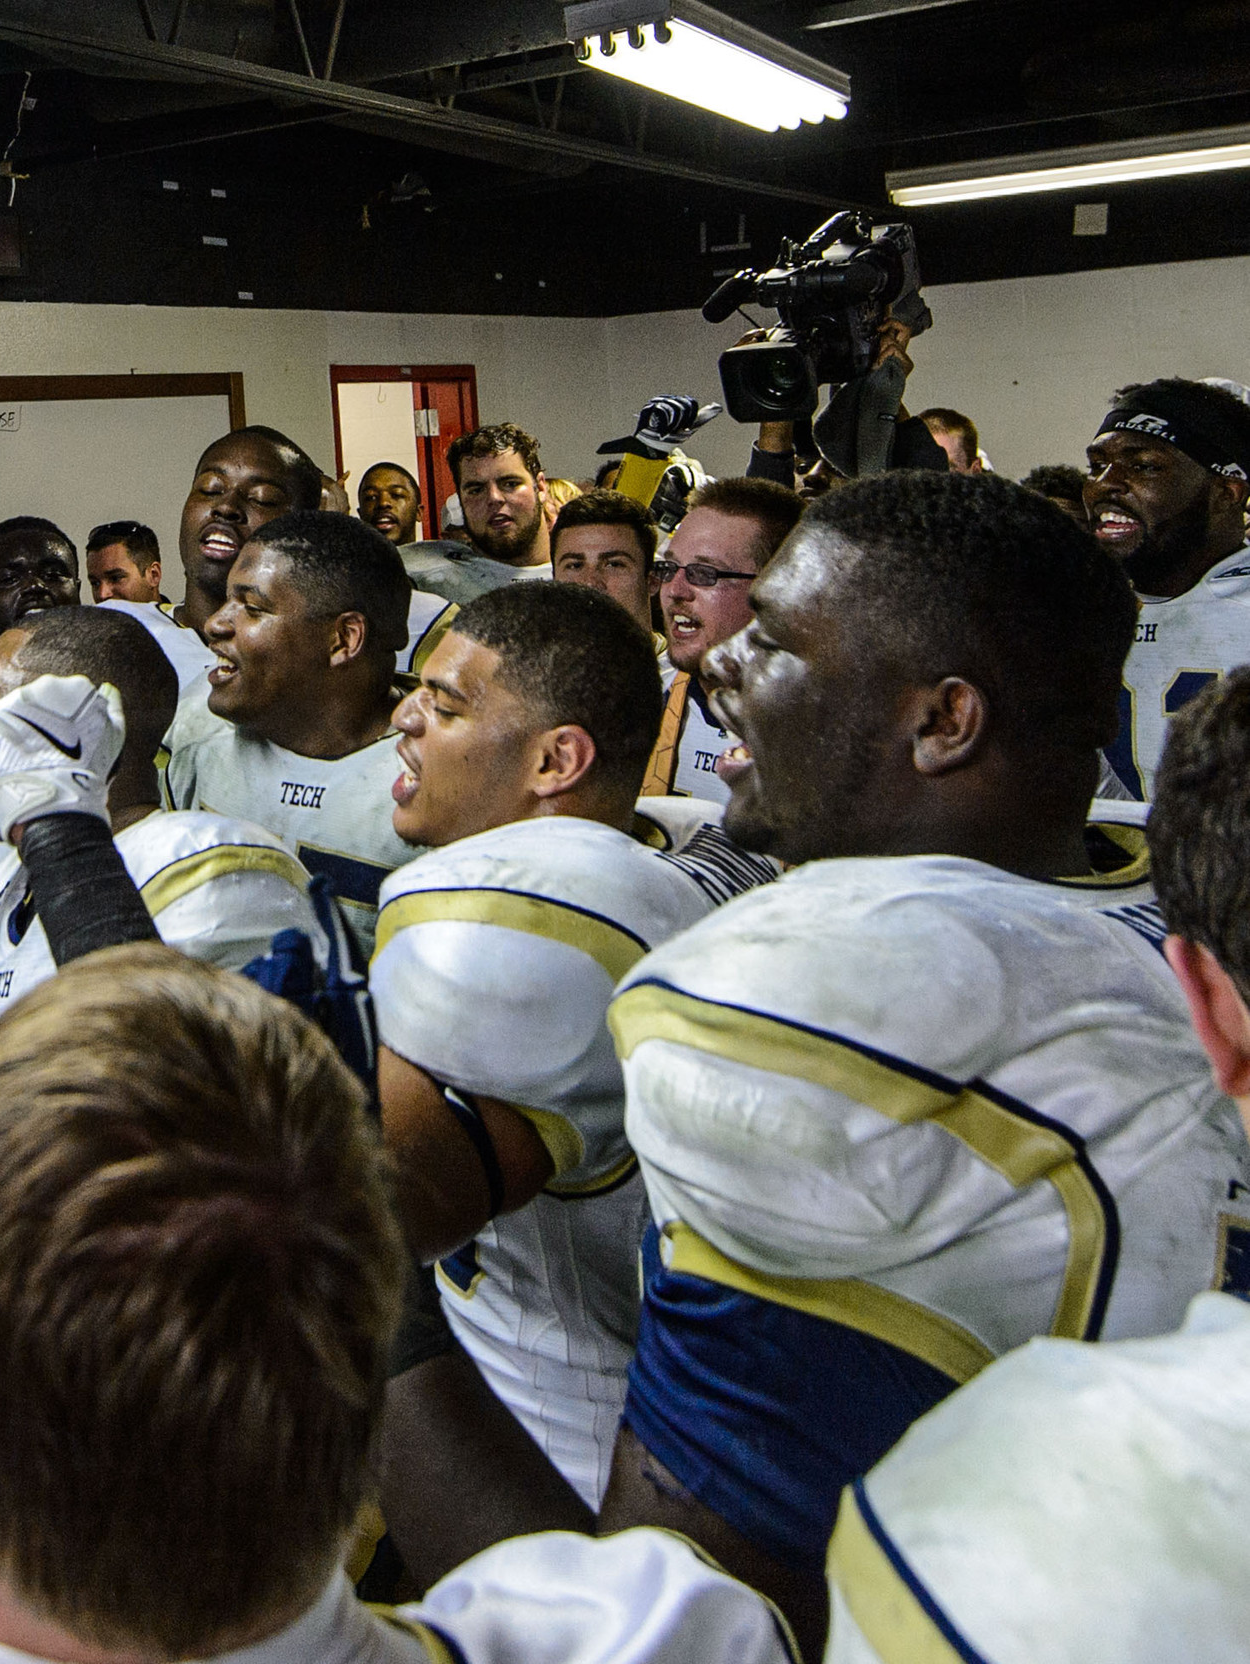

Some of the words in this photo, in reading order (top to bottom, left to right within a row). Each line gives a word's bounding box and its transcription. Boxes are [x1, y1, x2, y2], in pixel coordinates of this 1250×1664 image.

[1134, 622, 1158, 642] CH
[694, 750, 720, 774] TEC
[280, 781, 326, 809] TECH
